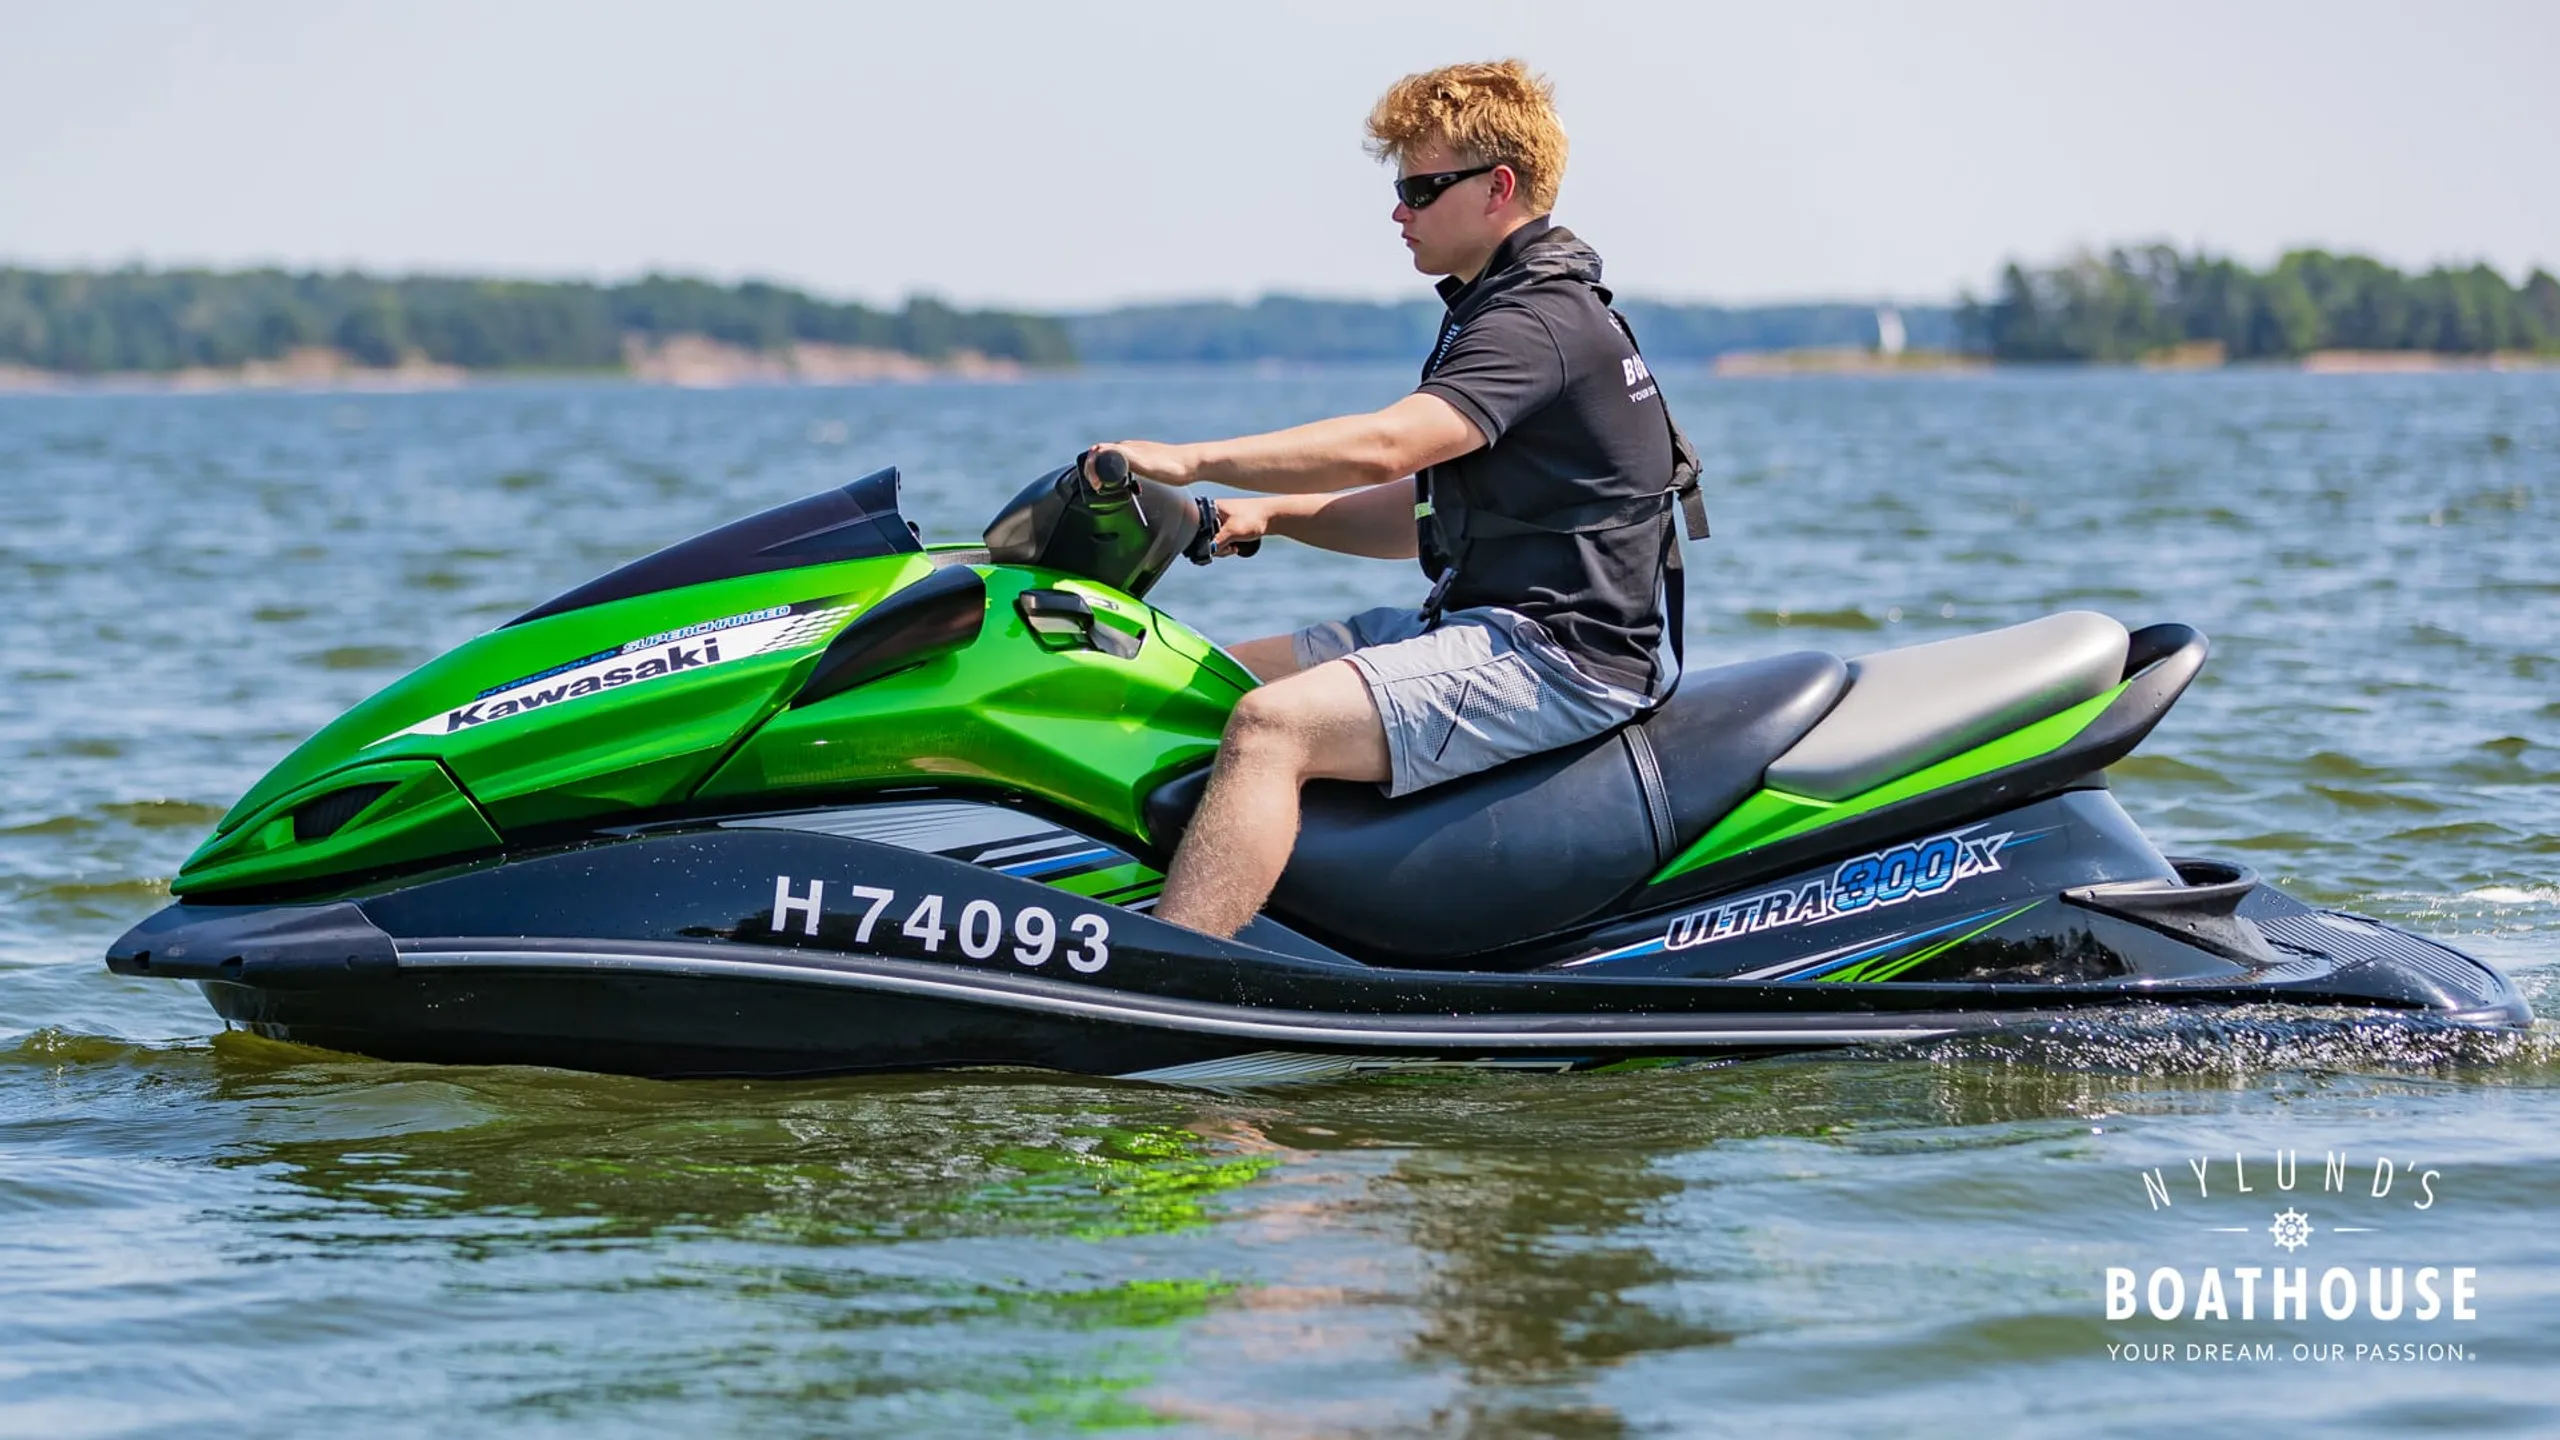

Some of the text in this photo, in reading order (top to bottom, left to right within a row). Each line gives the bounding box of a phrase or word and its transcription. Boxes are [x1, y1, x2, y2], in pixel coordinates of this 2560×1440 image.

[622, 605, 792, 655] SUPERCHARGED
[446, 637, 721, 733] Kawasaki
[770, 875, 1111, 974] H 74093
[1664, 880, 1830, 951] ULTRA
